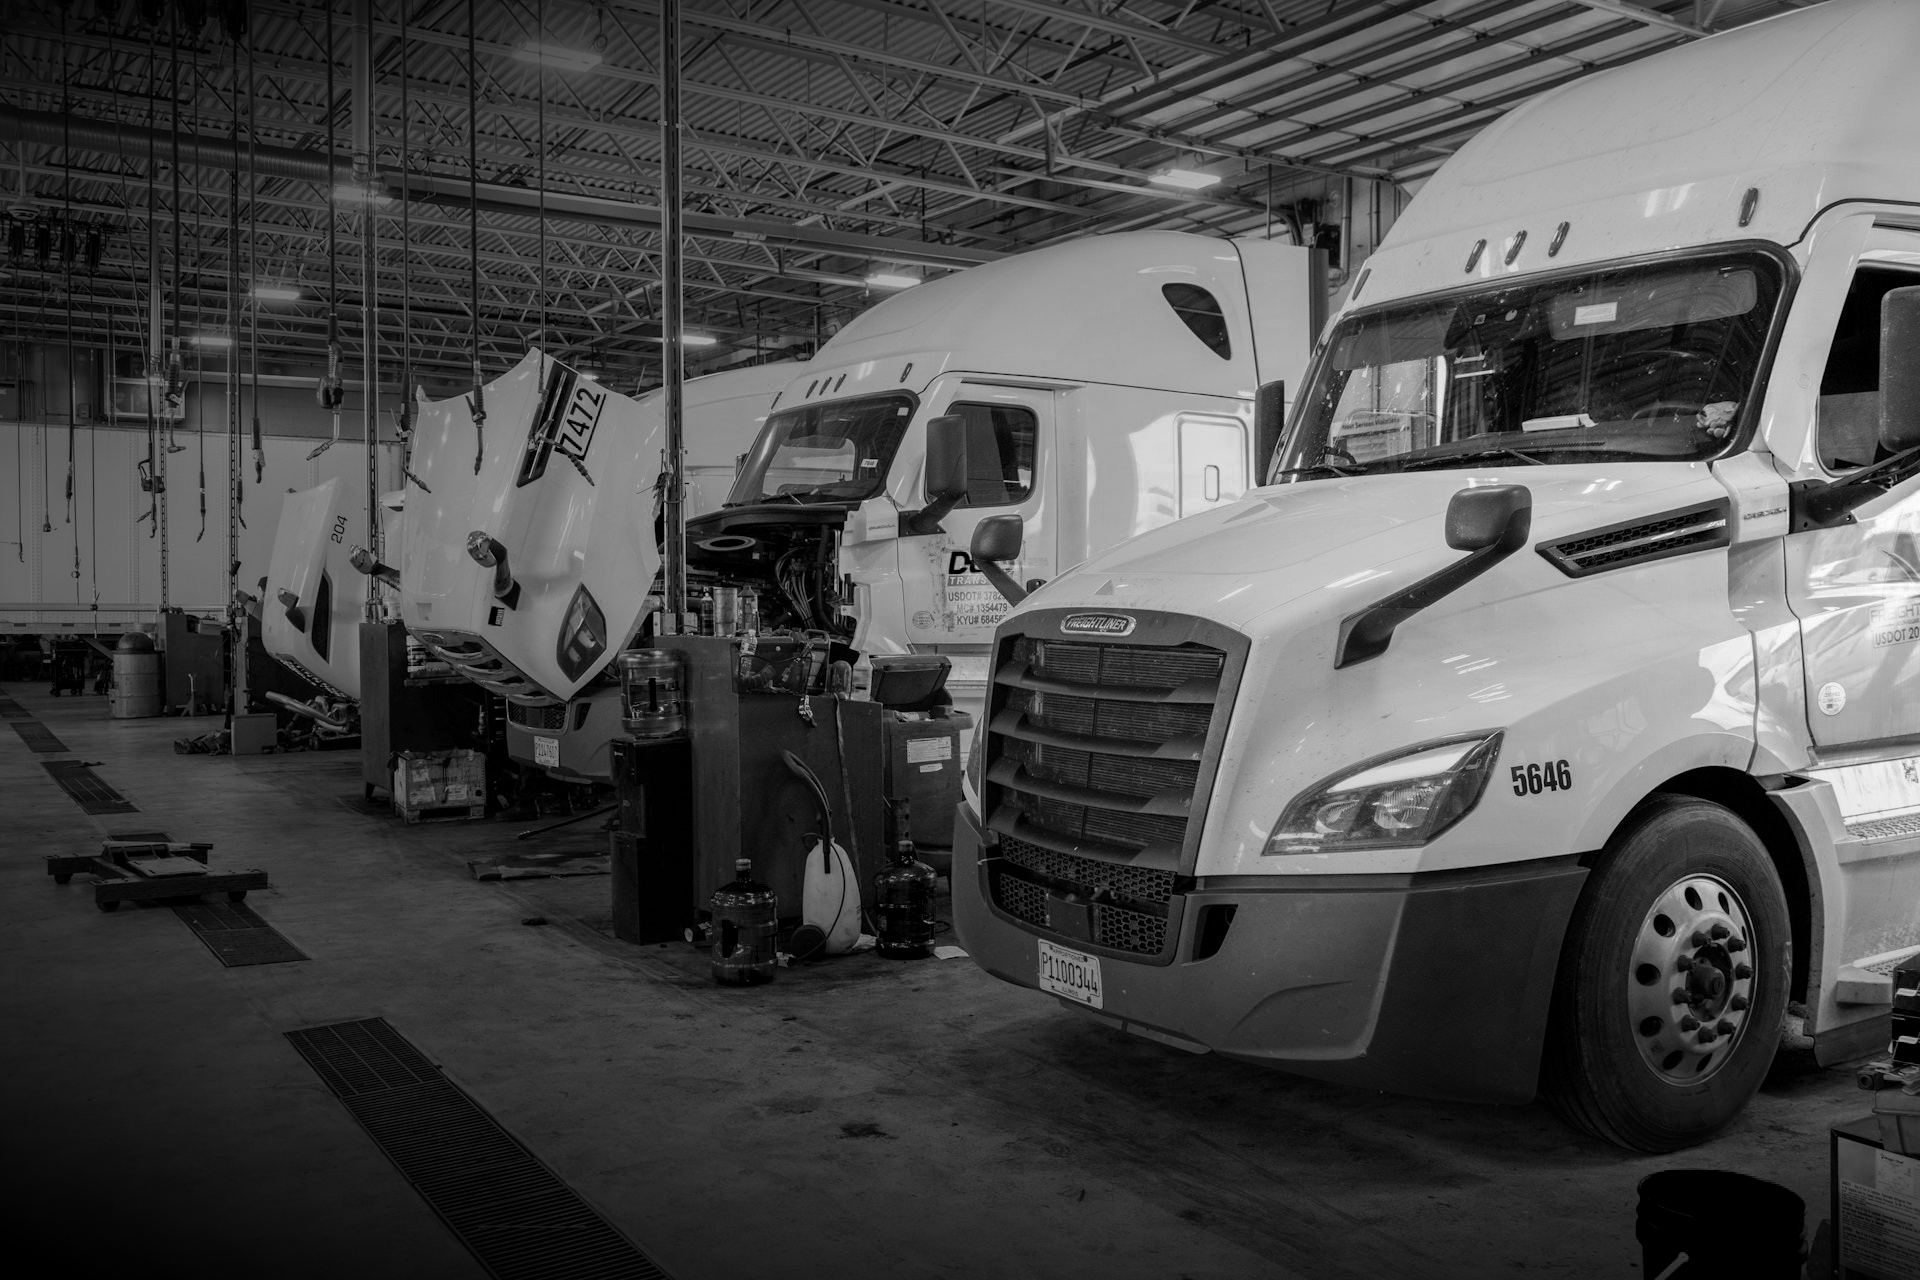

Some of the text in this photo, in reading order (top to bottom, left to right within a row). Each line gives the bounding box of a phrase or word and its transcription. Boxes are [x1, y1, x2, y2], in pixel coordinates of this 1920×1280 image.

[560, 388, 601, 452] 7472
[1355, 420, 1375, 428] Serious
[331, 515, 348, 544] 204
[950, 576, 988, 585] TRANS
[948, 591, 982, 602] USDOT#
[956, 602, 1008, 614] MC# 1354479
[956, 614, 1006, 625] KYU# 6845
[1065, 616, 1127, 631] FREIGHTLINER
[1875, 628, 1906, 646] USDOT
[1510, 759, 1572, 797] 5646
[1042, 951, 1098, 994] P1100344
